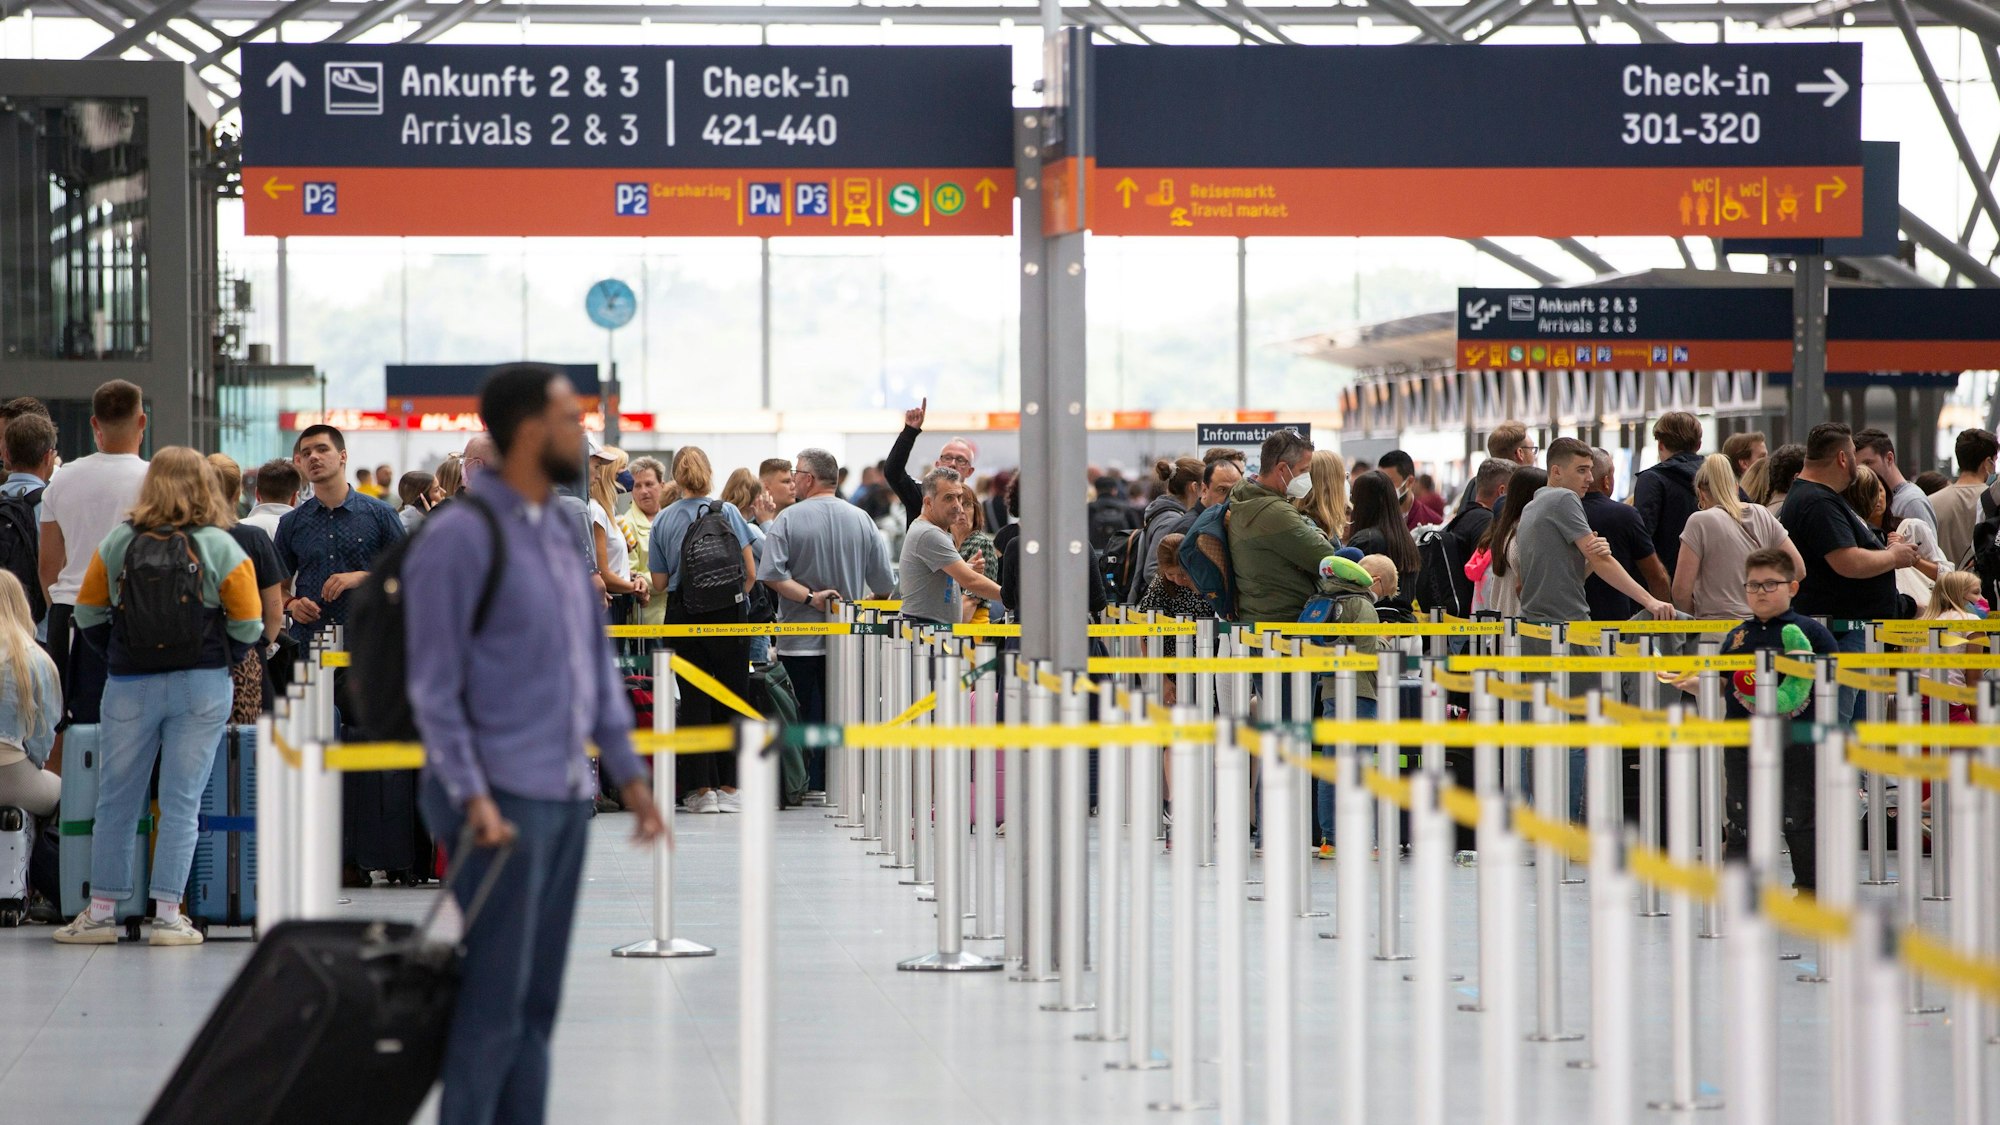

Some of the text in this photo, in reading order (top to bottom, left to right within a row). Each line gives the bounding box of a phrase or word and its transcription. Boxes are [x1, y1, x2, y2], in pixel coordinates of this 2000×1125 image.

[401, 65, 640, 97] Ankunft 2 & 3
[703, 65, 849, 98] Check-in
[1622, 64, 1770, 97] Check-in
[401, 113, 640, 146] Arrivals 2 & 3
[701, 113, 838, 146] 421-440
[1621, 112, 1761, 145] 301-320
[304, 183, 336, 214] P2
[616, 182, 732, 214] P2 Carsharing
[796, 183, 828, 214] P3
[891, 184, 918, 215] S
[1190, 183, 1276, 199] Reisemarkt
[1692, 178, 1714, 193] WC
[1740, 182, 1762, 197] WC
[1190, 202, 1288, 218] Travel market
[1538, 297, 1638, 313] Ankunft 2 & 3
[1538, 316, 1637, 333] Arrivals 2 & 3
[1202, 428, 1275, 441] Informatio
